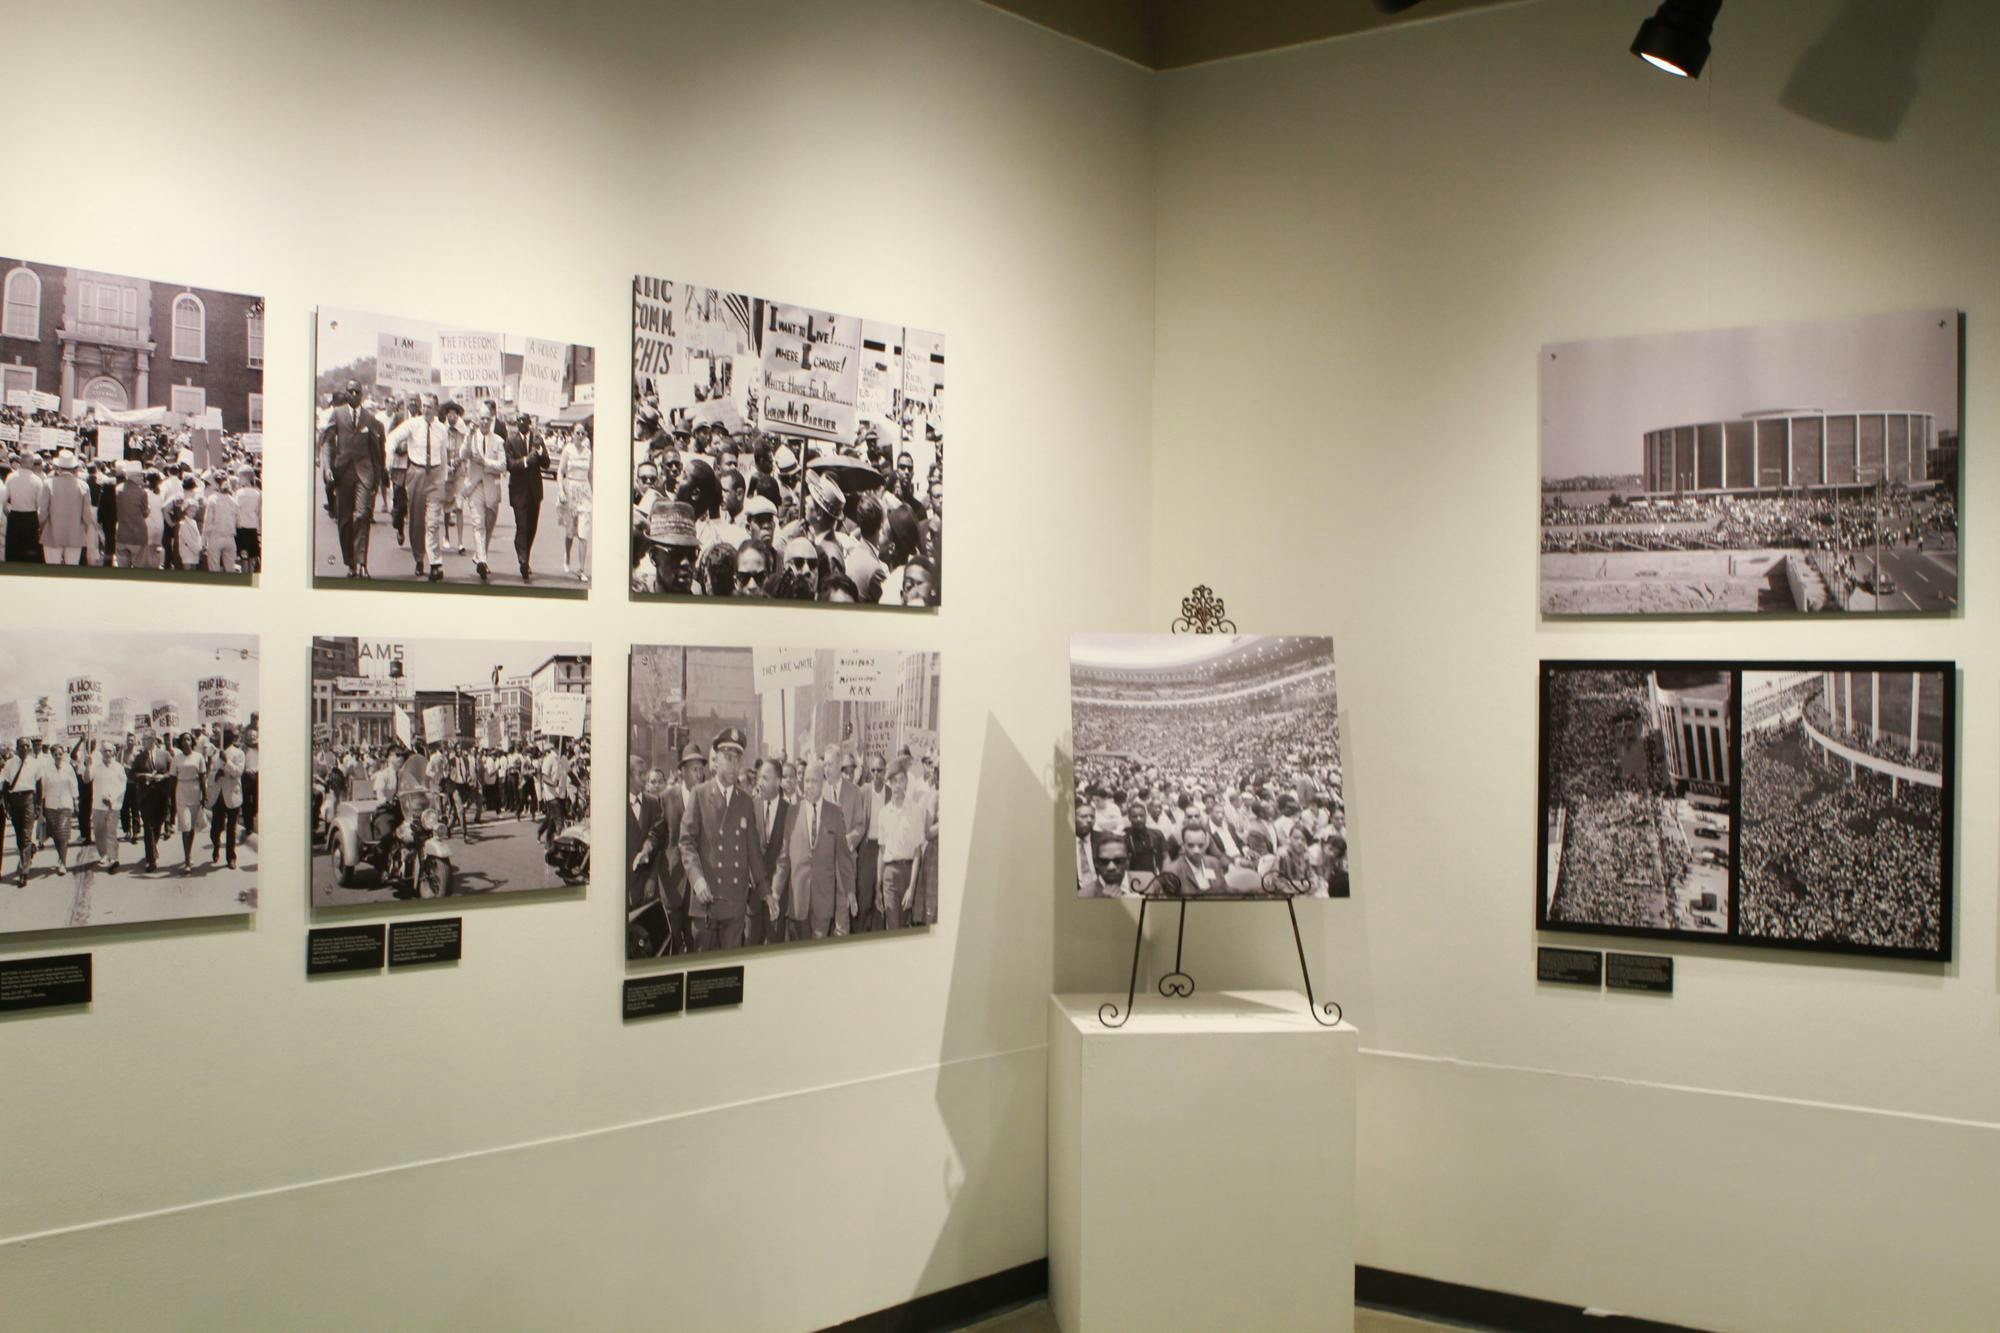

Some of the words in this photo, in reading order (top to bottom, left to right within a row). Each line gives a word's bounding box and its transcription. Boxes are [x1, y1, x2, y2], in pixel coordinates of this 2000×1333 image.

[778, 322, 796, 336] WANT
[799, 325, 806, 338] TO
[394, 337, 398, 346] I
[401, 338, 414, 349] AM
[440, 336, 457, 349] THE
[443, 352, 454, 364] WE
[457, 352, 473, 365] LOSE
[478, 353, 494, 366] MAY
[775, 347, 800, 363] WHERE
[801, 342, 812, 371] I
[813, 356, 847, 374] CHOOSE!
[457, 368, 480, 381] YOUR
[764, 370, 785, 392] WHITE
[802, 404, 837, 430] BARRIER
[359, 643, 404, 660] AMS
[69, 682, 75, 694] A
[198, 678, 215, 692] FAIR
